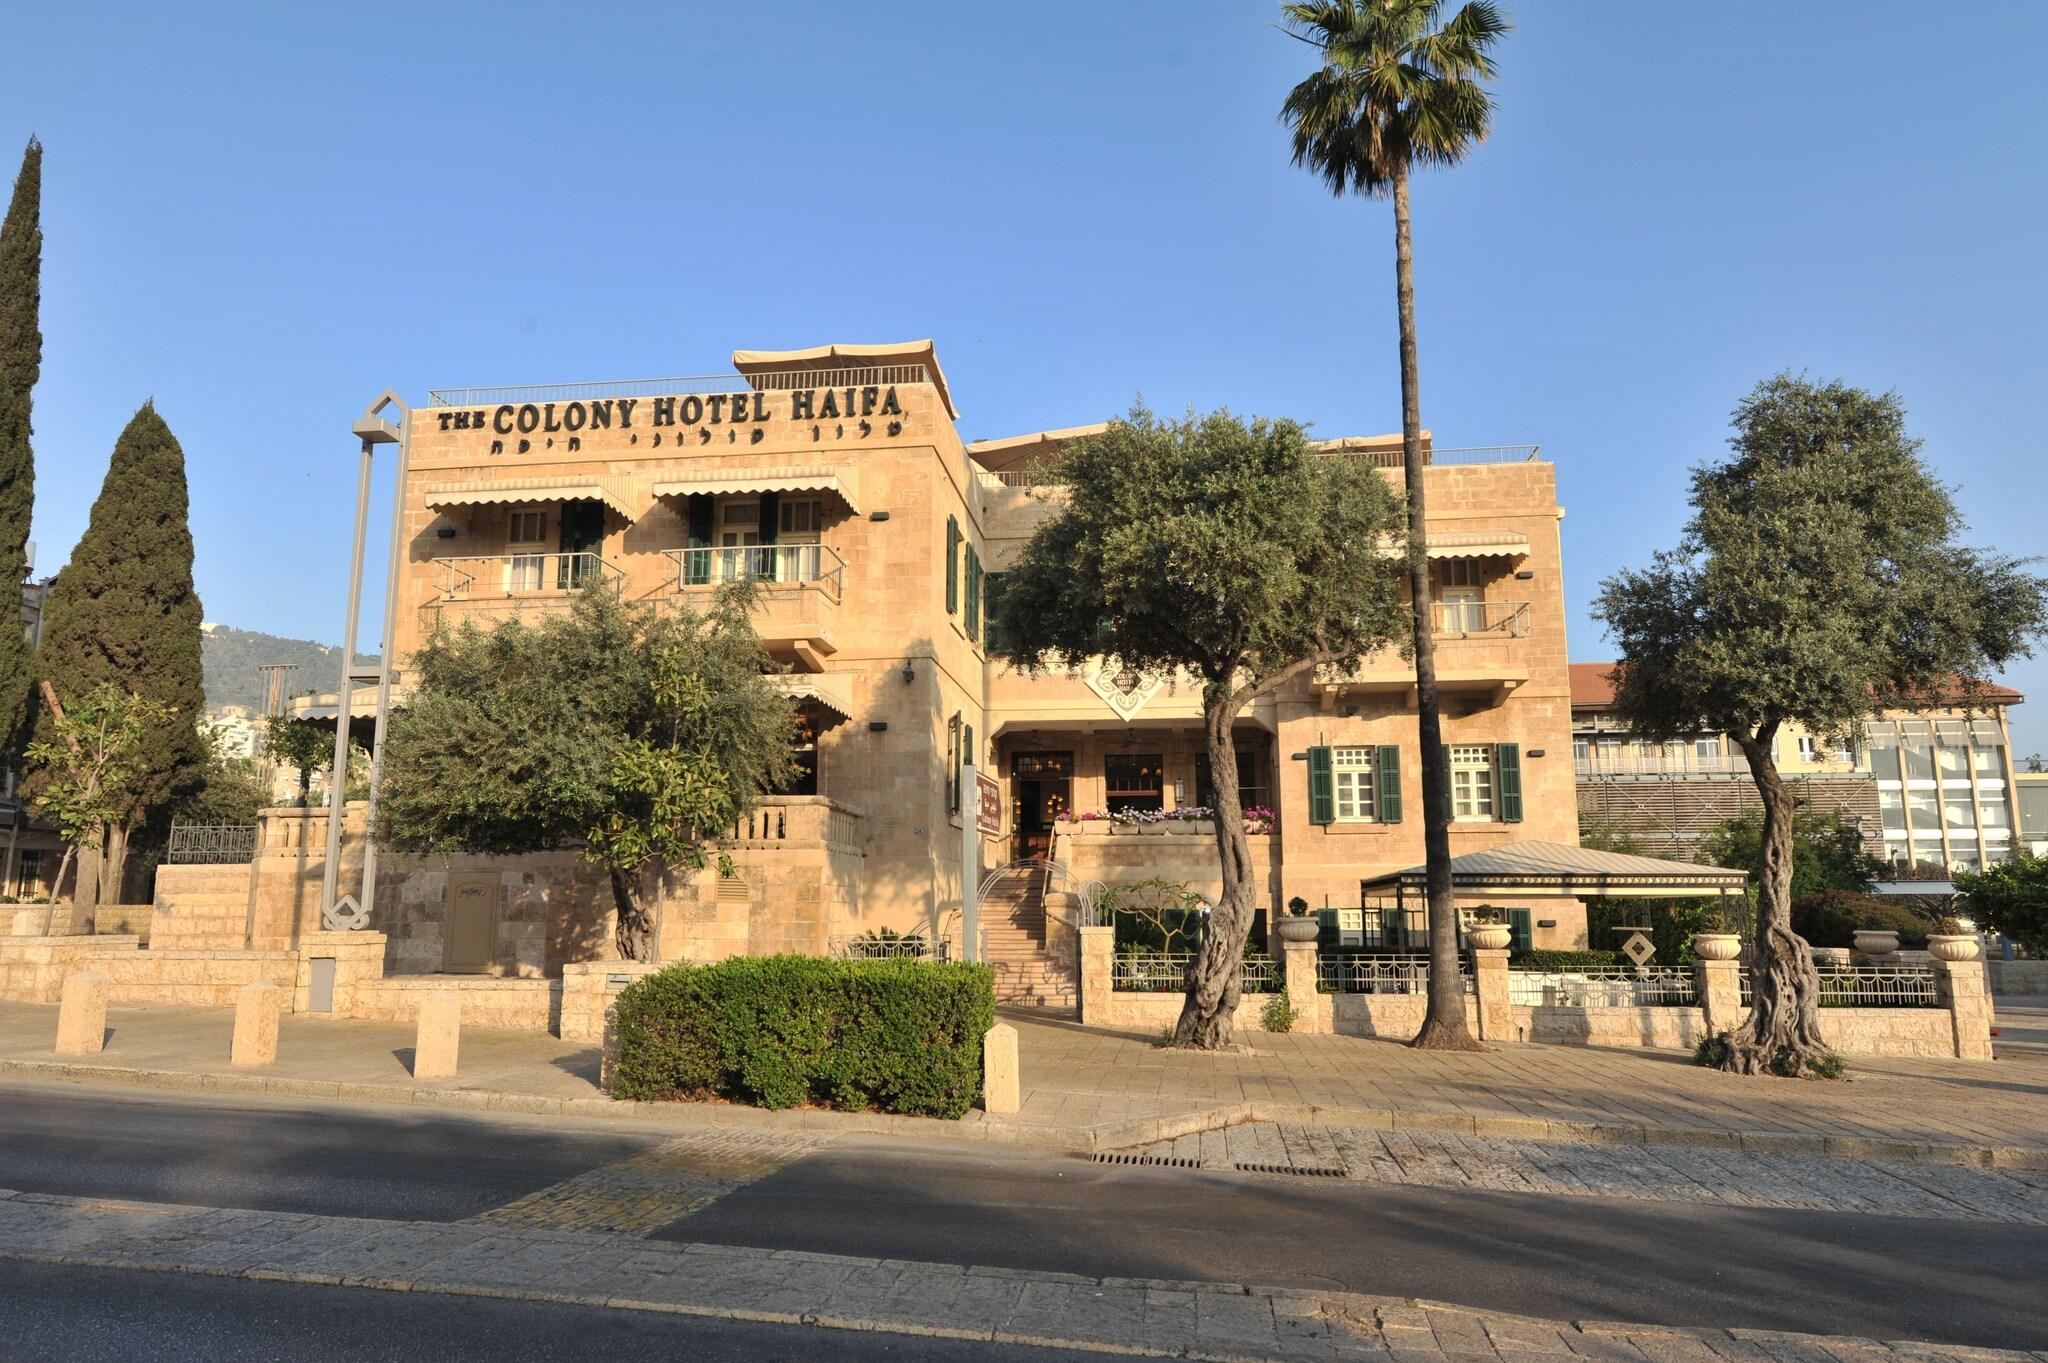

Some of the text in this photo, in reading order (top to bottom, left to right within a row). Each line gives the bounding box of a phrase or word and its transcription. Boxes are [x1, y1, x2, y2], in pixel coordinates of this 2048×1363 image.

[437, 385, 903, 435] THE COLONY HOTEL HAIFA
[489, 436, 582, 456] חיפה
